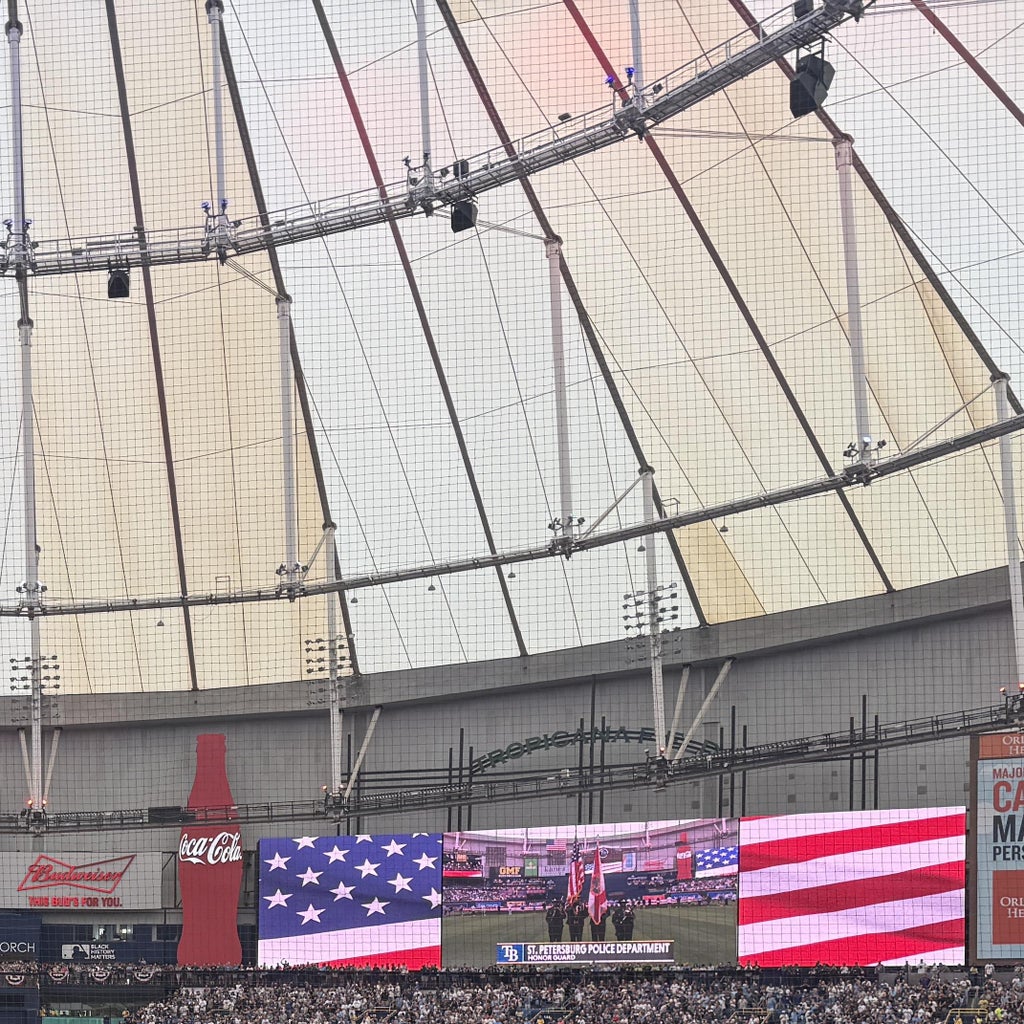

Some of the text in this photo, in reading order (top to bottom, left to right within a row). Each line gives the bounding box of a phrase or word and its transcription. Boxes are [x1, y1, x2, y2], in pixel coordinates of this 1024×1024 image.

[473, 726, 633, 773] TROPICANA
[993, 767, 1024, 779] MAJO
[179, 832, 242, 865] Coca-Cola
[28, 864, 123, 883] Budweiser
[29, 896, 123, 907] THIS BUD'S FOR YOU.
[501, 945, 518, 961] TB
[527, 943, 670, 955] ST. PETERSBURG POLICE DEPARTMENT
